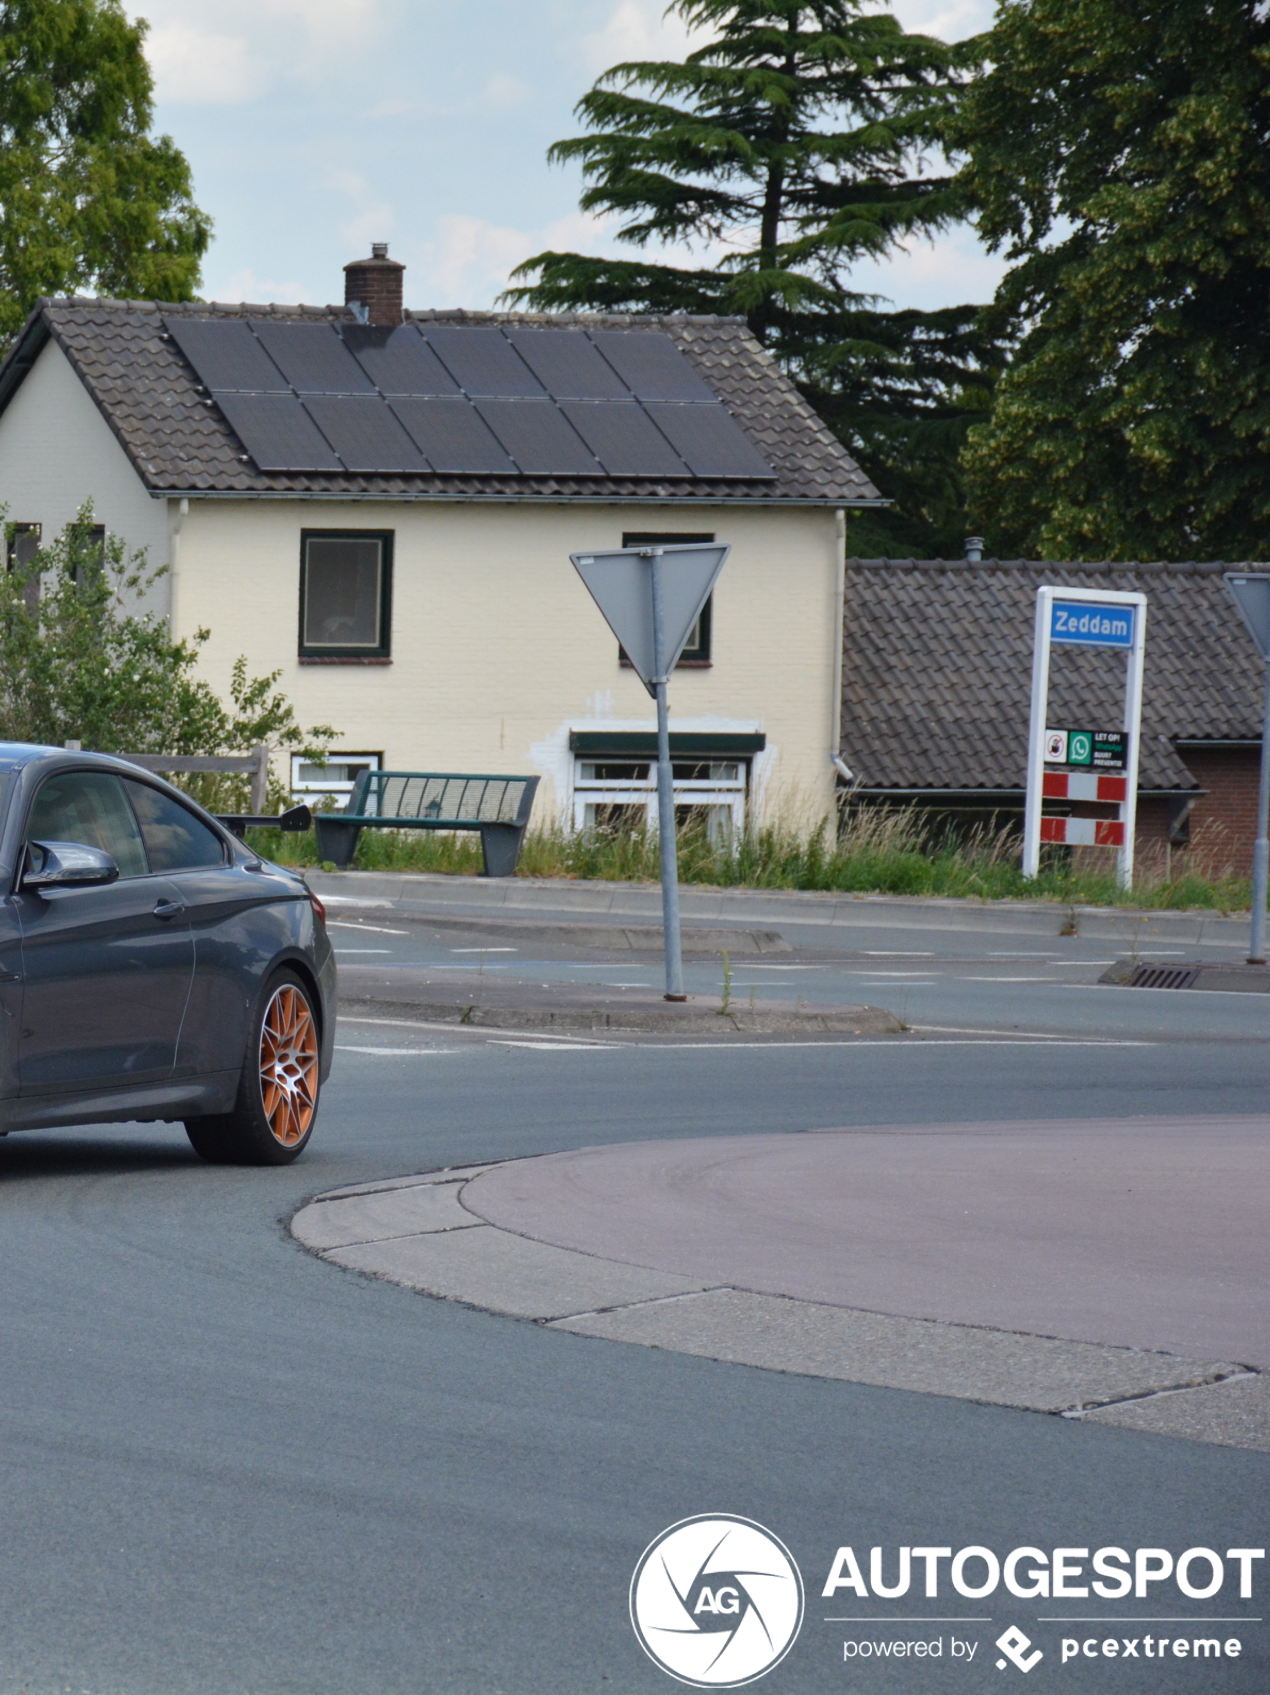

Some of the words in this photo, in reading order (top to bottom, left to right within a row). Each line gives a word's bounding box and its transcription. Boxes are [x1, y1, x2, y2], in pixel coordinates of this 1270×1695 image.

[1055, 611, 1128, 636] Zeddam
[1095, 733, 1107, 741] LET
[1108, 734, 1121, 742] OP!
[1095, 742, 1123, 752] WhatsApp
[1094, 759, 1122, 767] PREVENTIE
